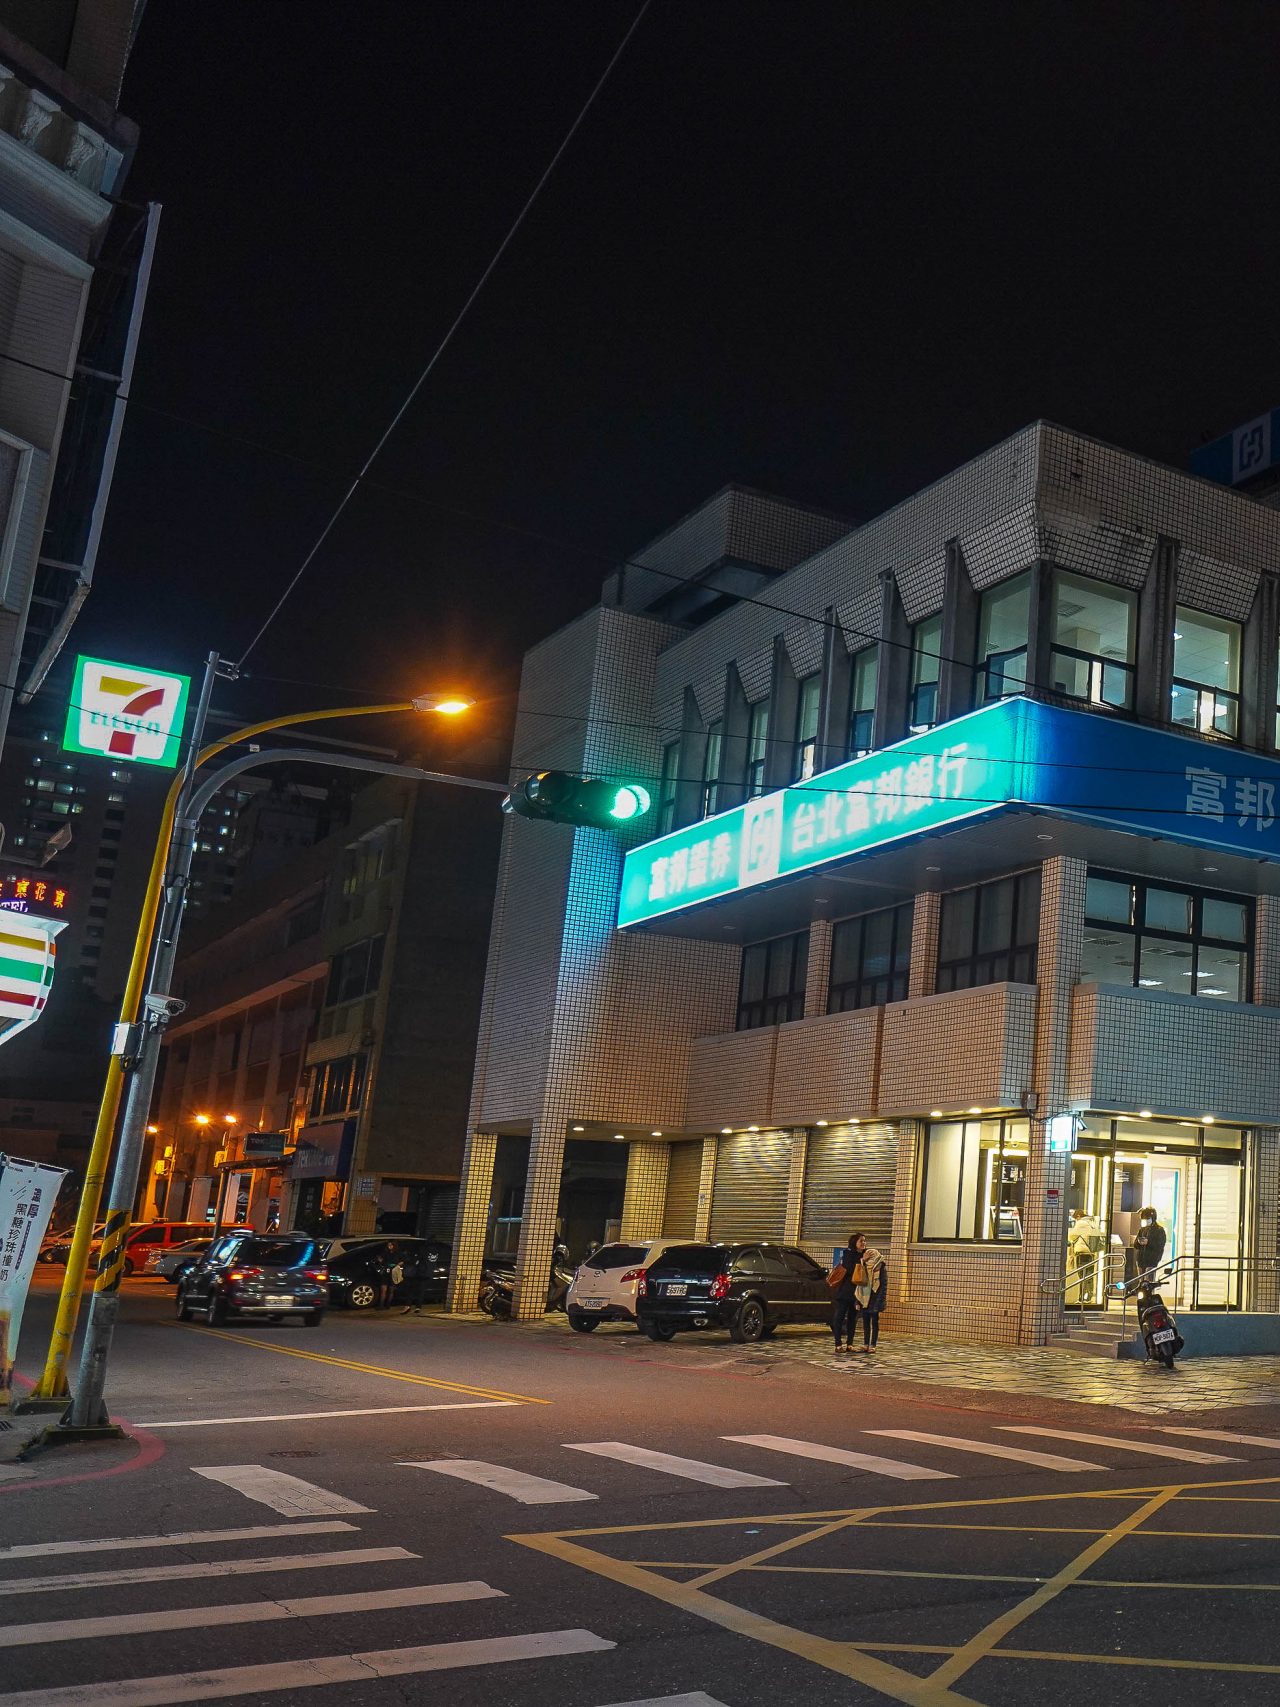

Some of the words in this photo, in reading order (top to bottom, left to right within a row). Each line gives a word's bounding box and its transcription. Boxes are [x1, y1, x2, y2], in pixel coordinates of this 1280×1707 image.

[791, 742, 969, 853] 台北富邦銀行
